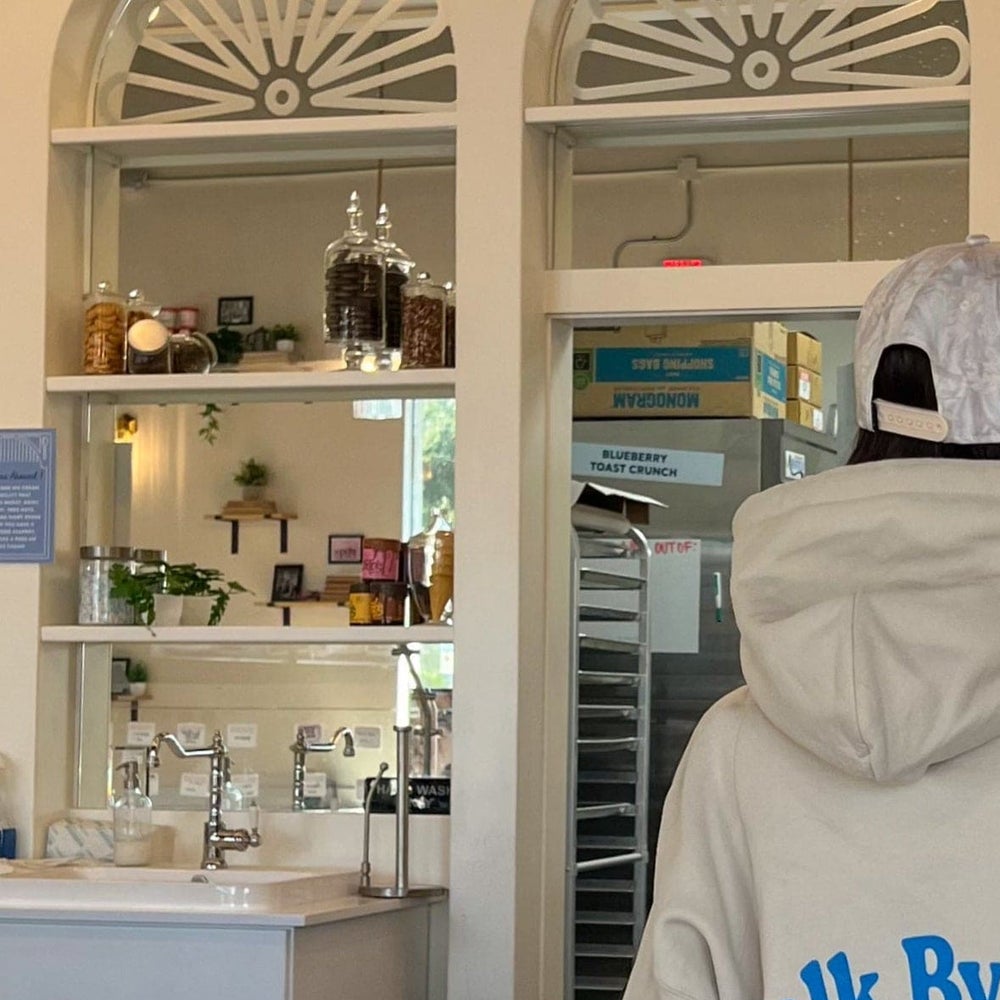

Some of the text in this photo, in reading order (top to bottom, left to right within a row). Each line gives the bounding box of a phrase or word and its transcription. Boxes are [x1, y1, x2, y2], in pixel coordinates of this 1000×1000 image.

[632, 358, 715, 370] SHOPPING BAGS
[613, 392, 700, 409] MONOGRAM
[602, 449, 668, 463] BLUEBERRY
[590, 462, 678, 477] TOAST CRUNCH
[654, 541, 676, 554] OUT
